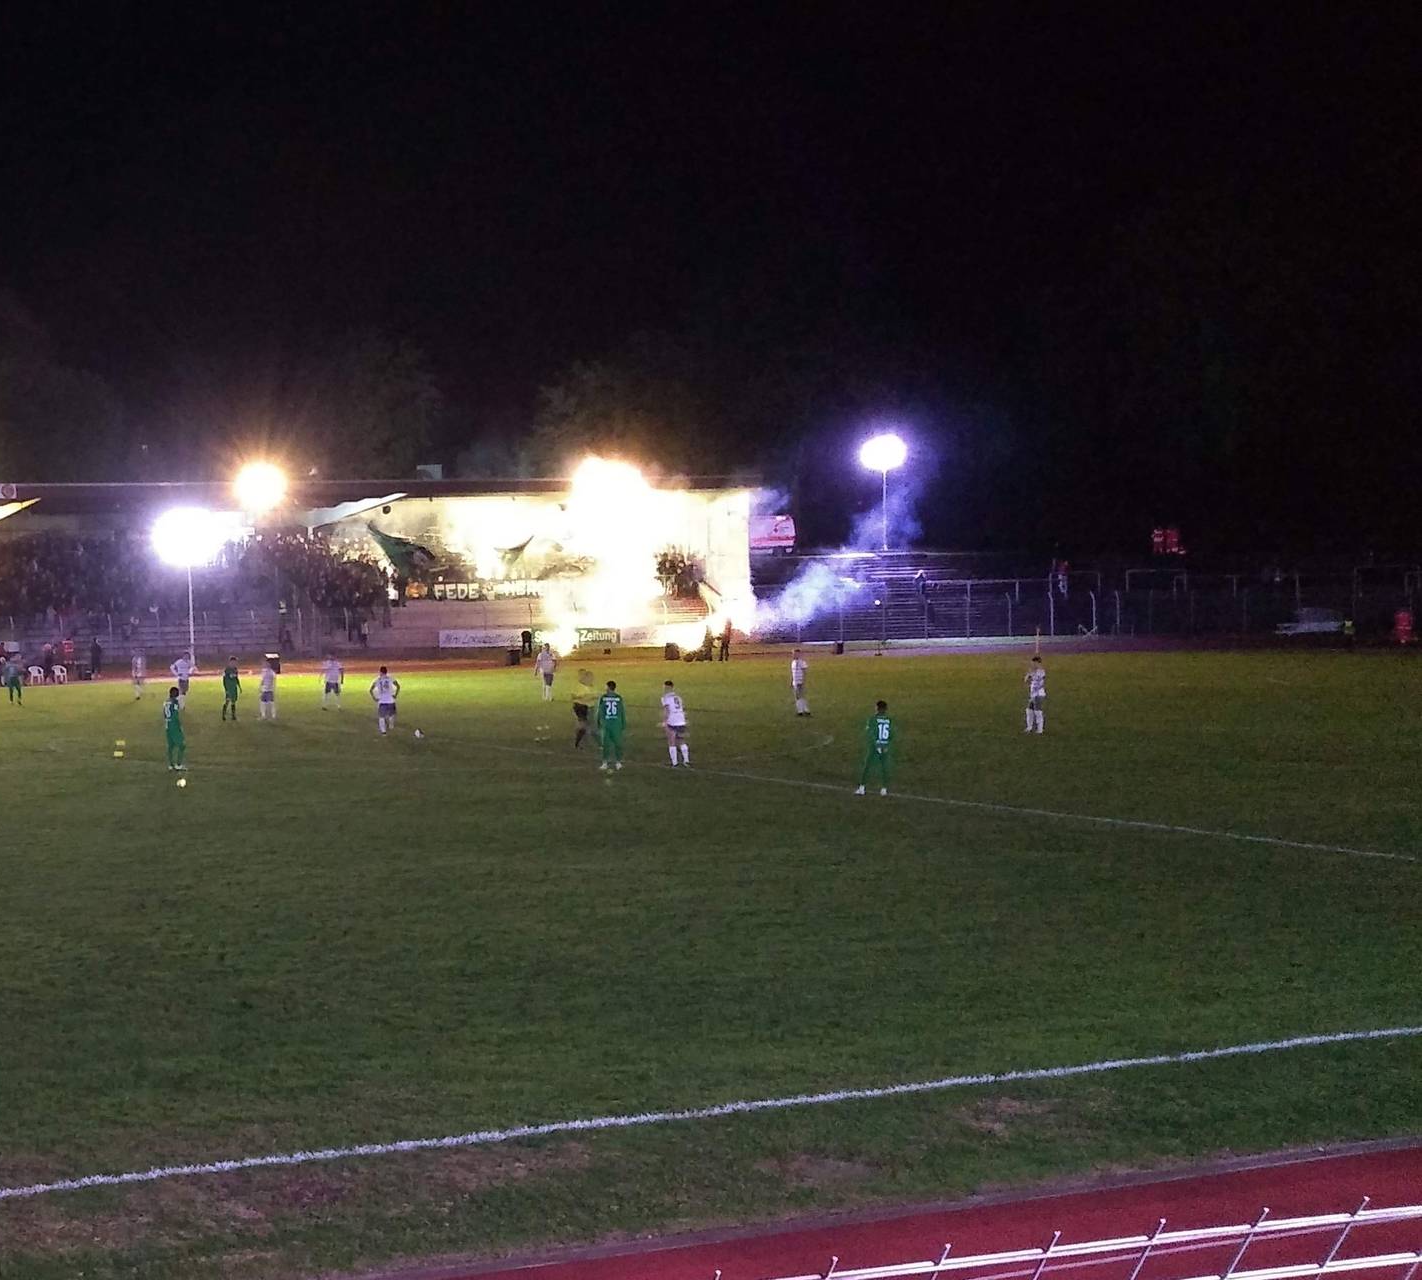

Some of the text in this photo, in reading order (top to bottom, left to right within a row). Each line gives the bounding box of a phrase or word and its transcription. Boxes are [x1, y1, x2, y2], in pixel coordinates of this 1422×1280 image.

[580, 630, 617, 644] Zeitung
[605, 701, 618, 716] 26
[878, 723, 889, 740] 16
